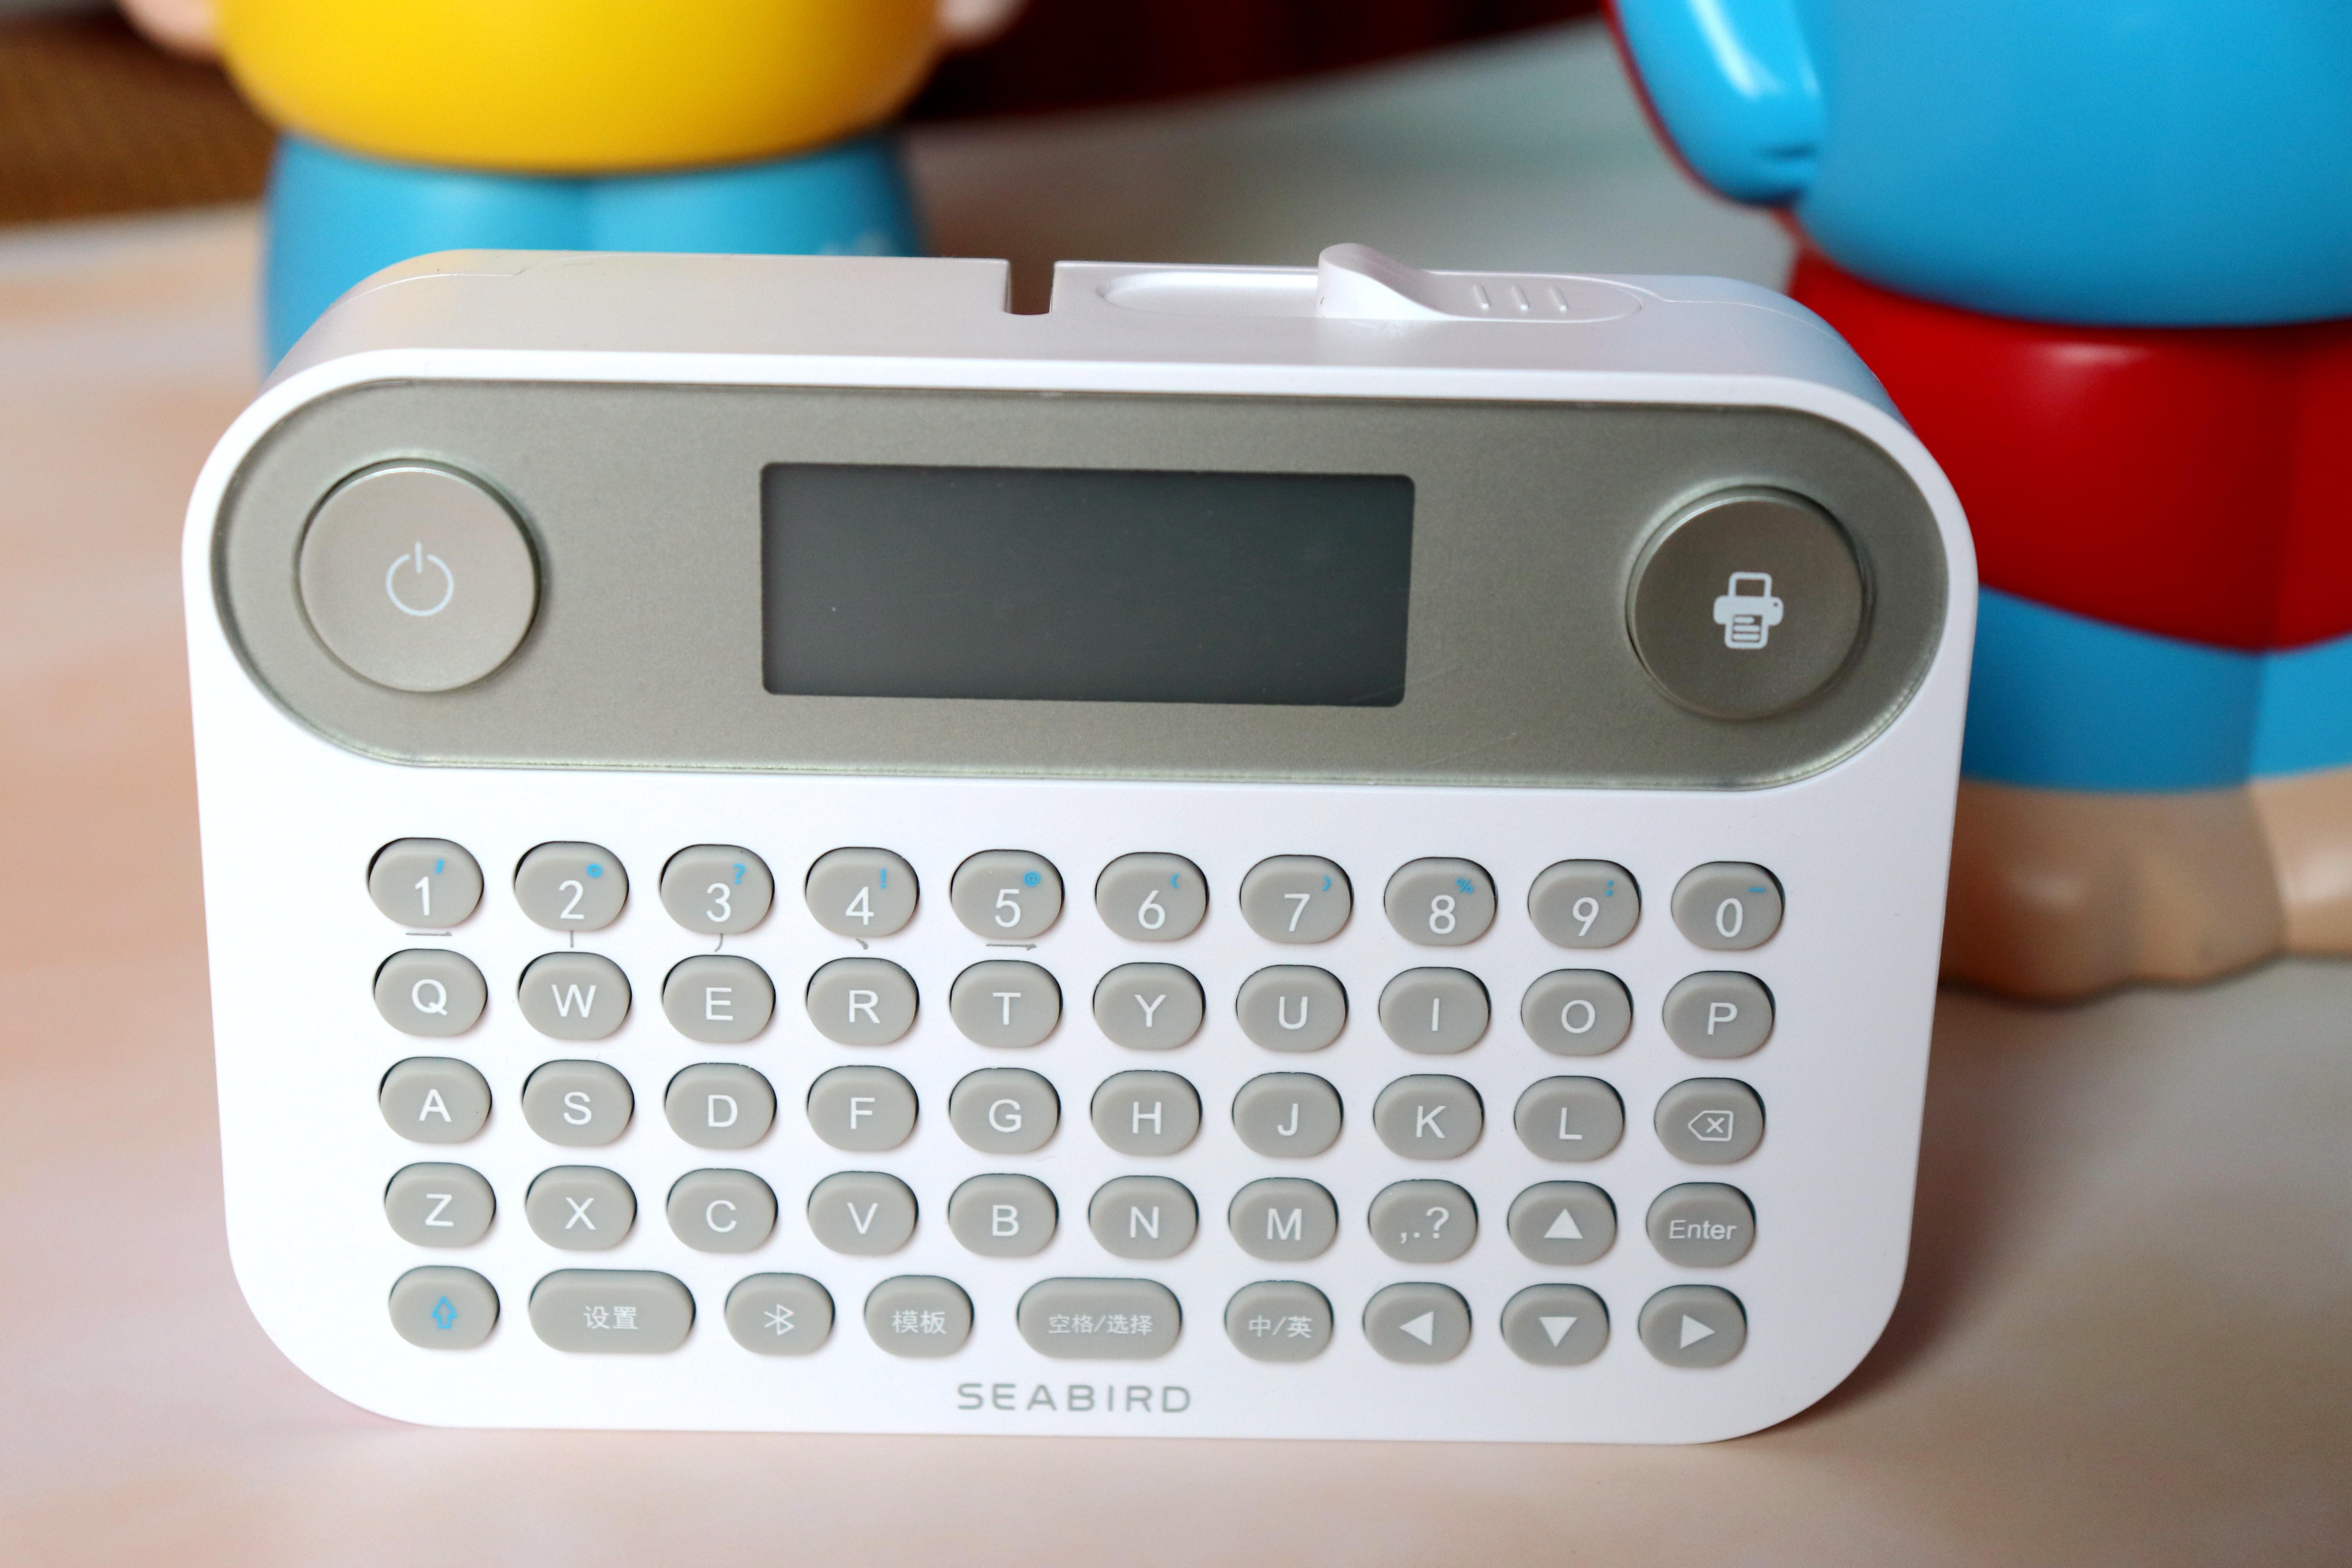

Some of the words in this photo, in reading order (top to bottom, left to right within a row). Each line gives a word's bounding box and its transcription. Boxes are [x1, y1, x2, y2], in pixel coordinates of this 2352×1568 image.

[414, 876, 430, 916] 1
[1022, 871, 1042, 887] @
[1455, 877, 1474, 894] %
[559, 880, 585, 920] 2
[706, 882, 731, 923] 3
[845, 886, 875, 926] 4
[995, 888, 1021, 928] 5
[1138, 889, 1166, 930] 6
[1284, 893, 1310, 932] 7
[1429, 894, 1456, 935] 8
[1572, 897, 1599, 937] 9
[1715, 897, 1743, 938] 0
[411, 978, 448, 1016] Q
[551, 984, 597, 1018] W
[706, 987, 734, 1021] E
[849, 989, 881, 1024] R
[992, 992, 1022, 1025] T
[1134, 994, 1167, 1028] Y
[1278, 996, 1308, 1030] U
[1431, 998, 1440, 1032] I
[1561, 999, 1596, 1034] O
[1707, 1002, 1738, 1035] P
[419, 1089, 452, 1123] A
[563, 1091, 592, 1125] S
[708, 1094, 738, 1128] D
[850, 1097, 876, 1130] F
[988, 1098, 1022, 1133] G
[1132, 1101, 1162, 1135] H
[1277, 1103, 1299, 1136] J
[1416, 1105, 1446, 1139] K
[1559, 1107, 1583, 1140] L
[425, 1193, 454, 1227] Z
[564, 1197, 596, 1230] X
[706, 1200, 737, 1233] C
[847, 1202, 879, 1234] V
[992, 1204, 1019, 1237] B
[1130, 1206, 1159, 1239] N
[1267, 1208, 1302, 1241] M
[1669, 1219, 1737, 1240] Enter
[583, 1305, 639, 1330] 设置
[892, 1309, 947, 1335] 模板
[957, 1383, 1191, 1414] SEABIRD
